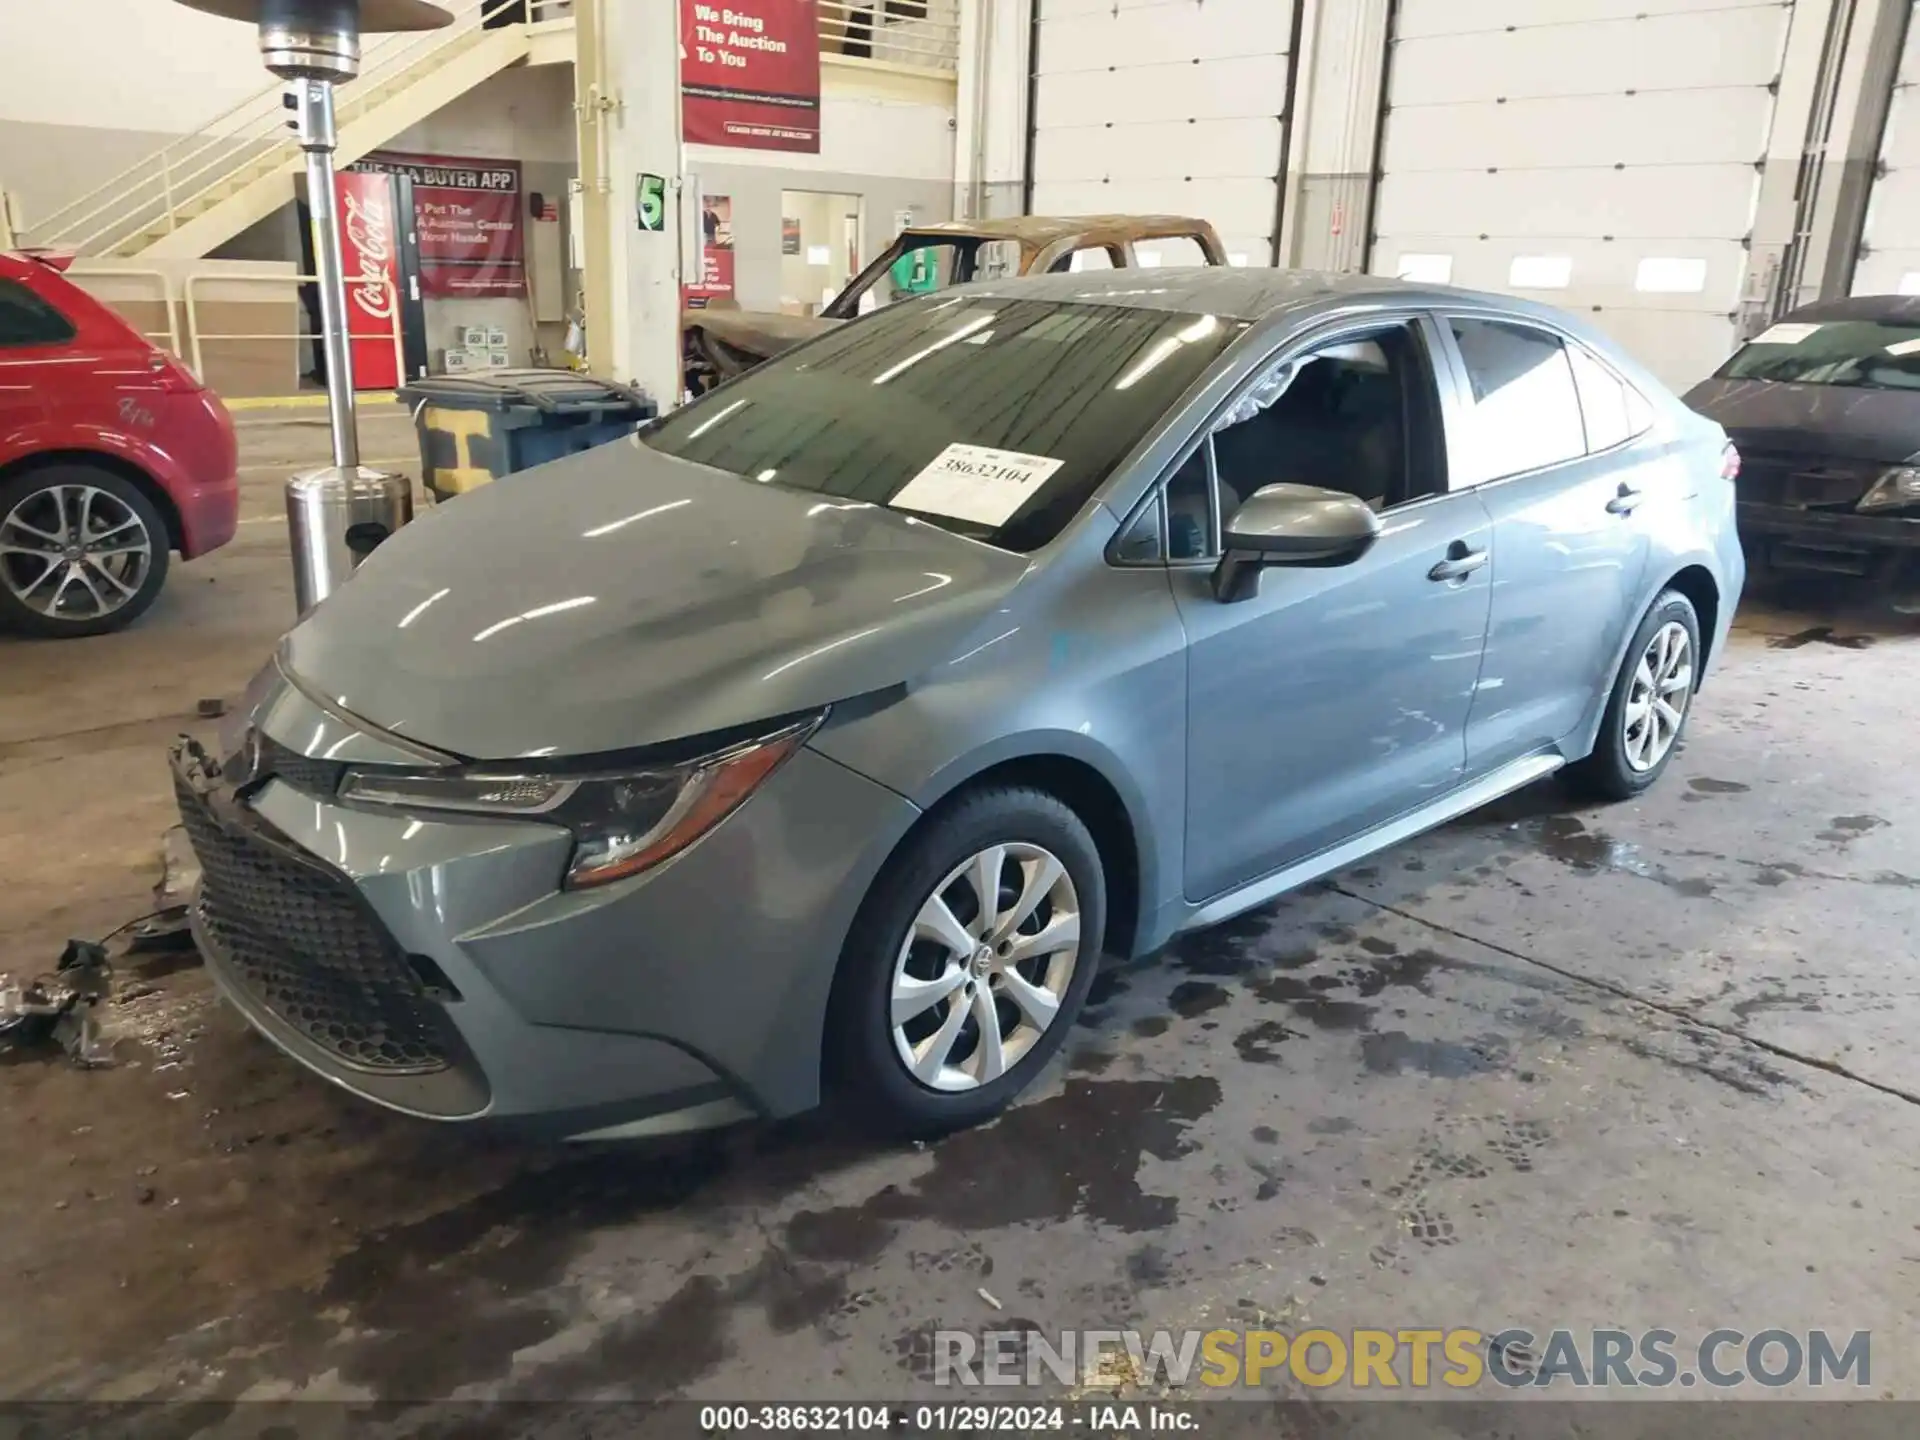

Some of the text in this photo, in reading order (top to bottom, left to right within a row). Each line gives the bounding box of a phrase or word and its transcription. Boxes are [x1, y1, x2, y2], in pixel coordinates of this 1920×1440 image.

[695, 4, 764, 32] We Bring
[696, 25, 786, 53] The Auction
[696, 46, 747, 67] To You
[424, 168, 476, 188] BUYER
[480, 171, 511, 189] APP
[424, 203, 447, 215] Put
[450, 204, 473, 216] The
[477, 218, 514, 231] Center
[421, 231, 448, 242] Your
[942, 457, 1033, 484] 38632104
